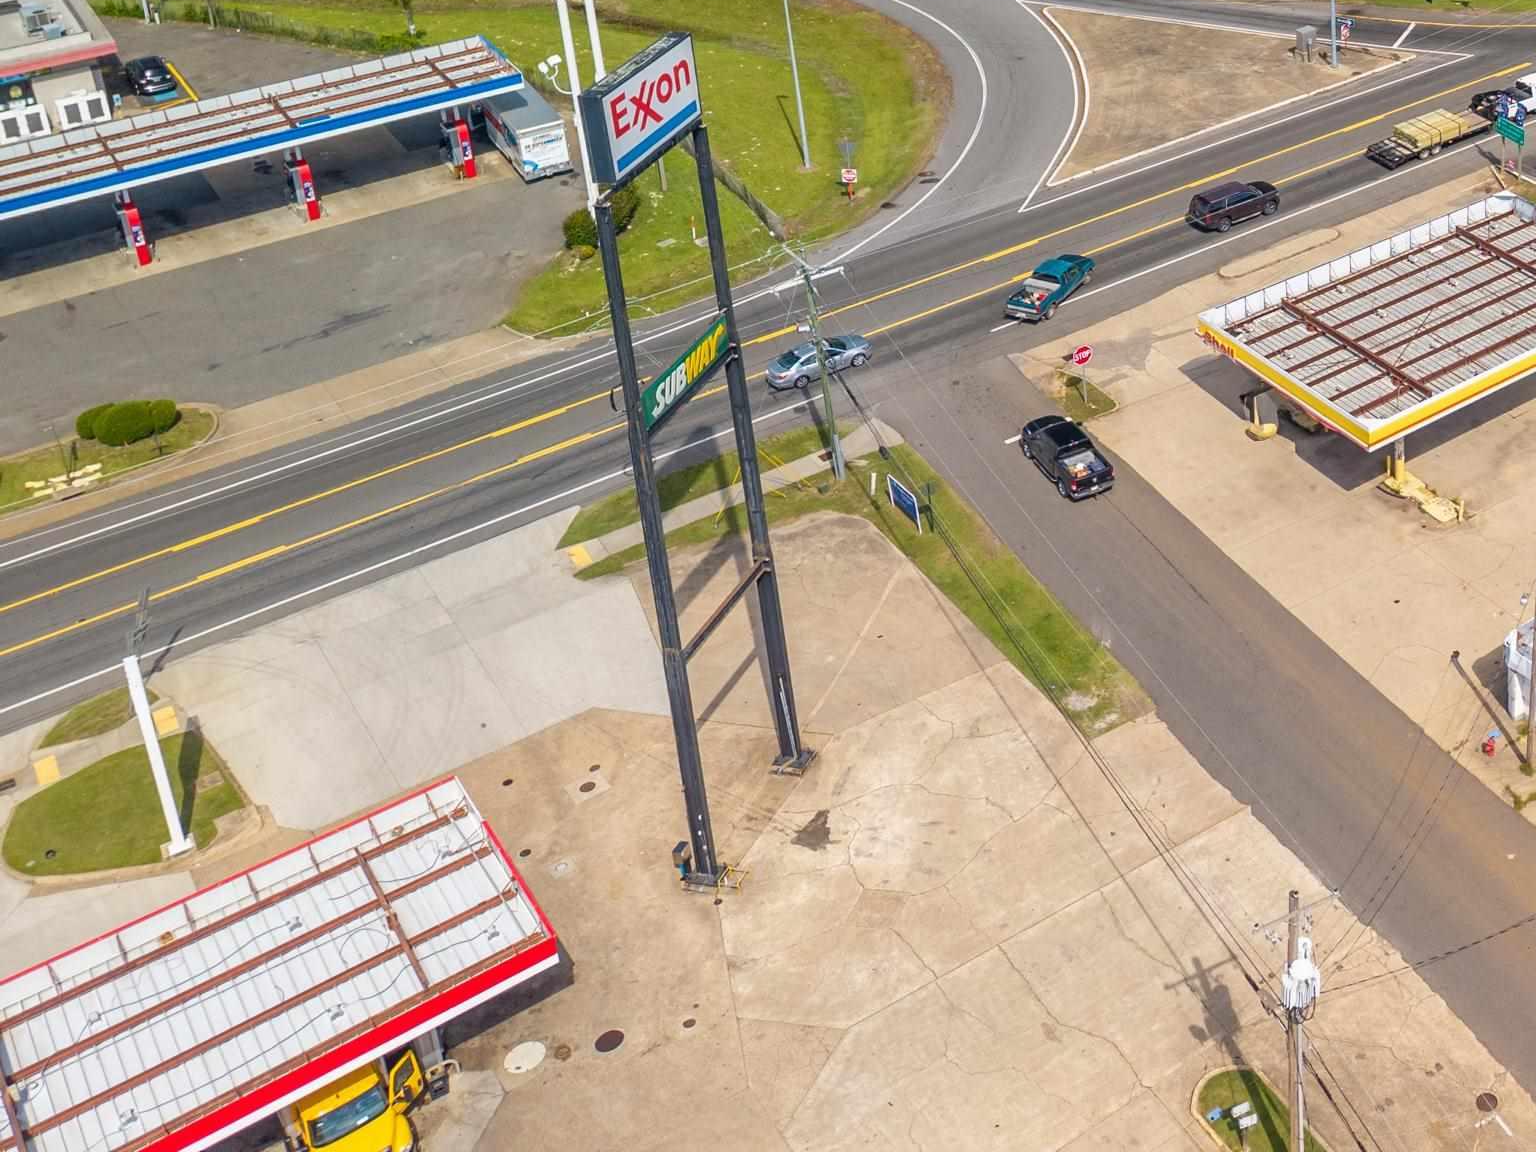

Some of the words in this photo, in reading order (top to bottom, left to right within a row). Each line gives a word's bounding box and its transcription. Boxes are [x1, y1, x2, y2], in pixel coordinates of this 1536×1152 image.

[610, 59, 690, 139] Exxon
[652, 323, 726, 418] SUBWAY
[1073, 349, 1090, 362] STOP
[1204, 331, 1234, 359] Shell
